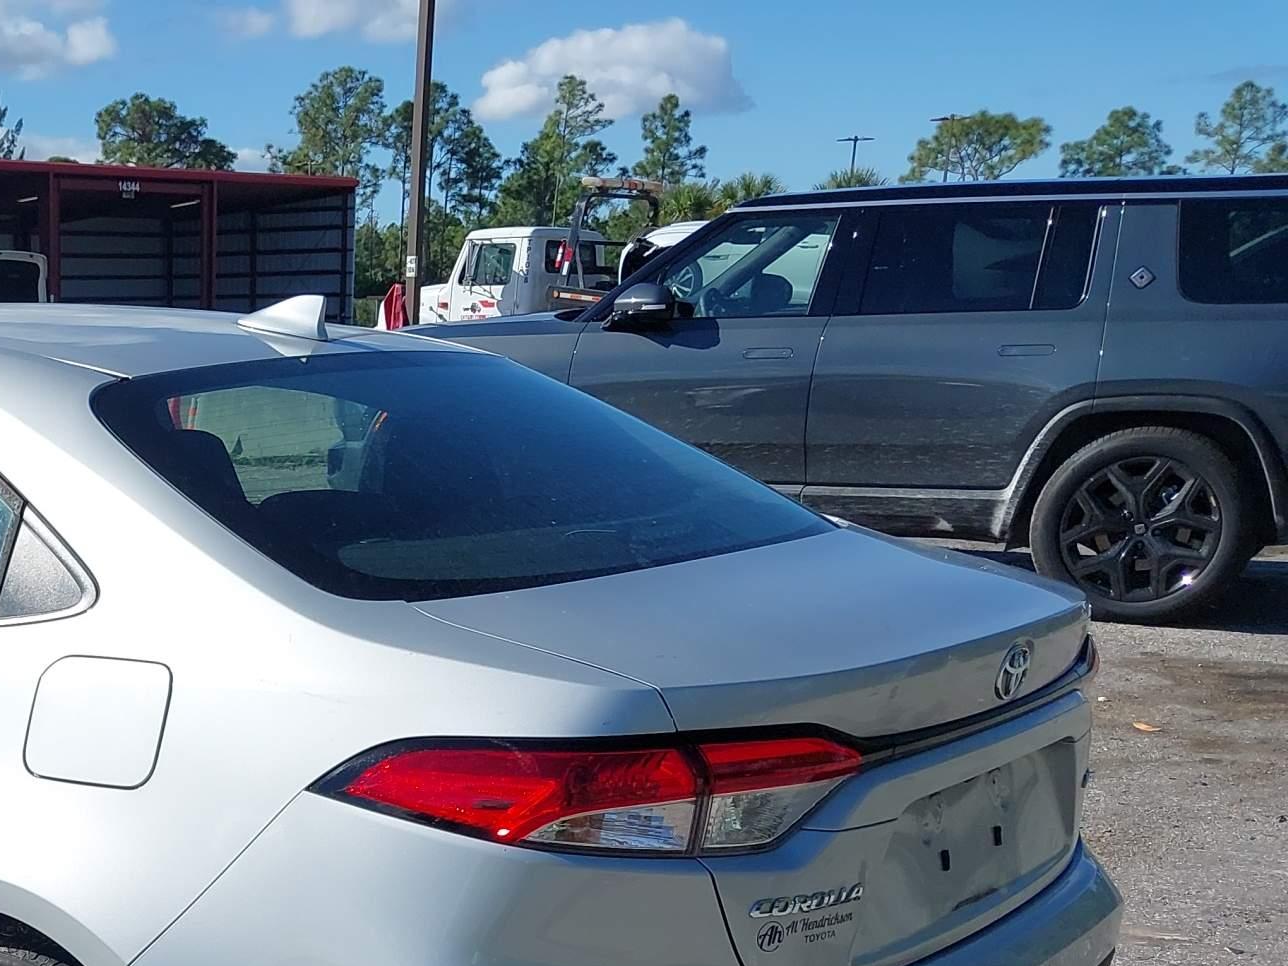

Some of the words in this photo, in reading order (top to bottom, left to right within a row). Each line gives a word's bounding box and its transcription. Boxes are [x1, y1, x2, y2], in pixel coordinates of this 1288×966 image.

[118, 180, 140, 192] 14344
[749, 882, 864, 918] COROLLA
[786, 920, 798, 936] Al
[800, 912, 854, 933] Hendrickson
[804, 930, 836, 944] TOYOTA
